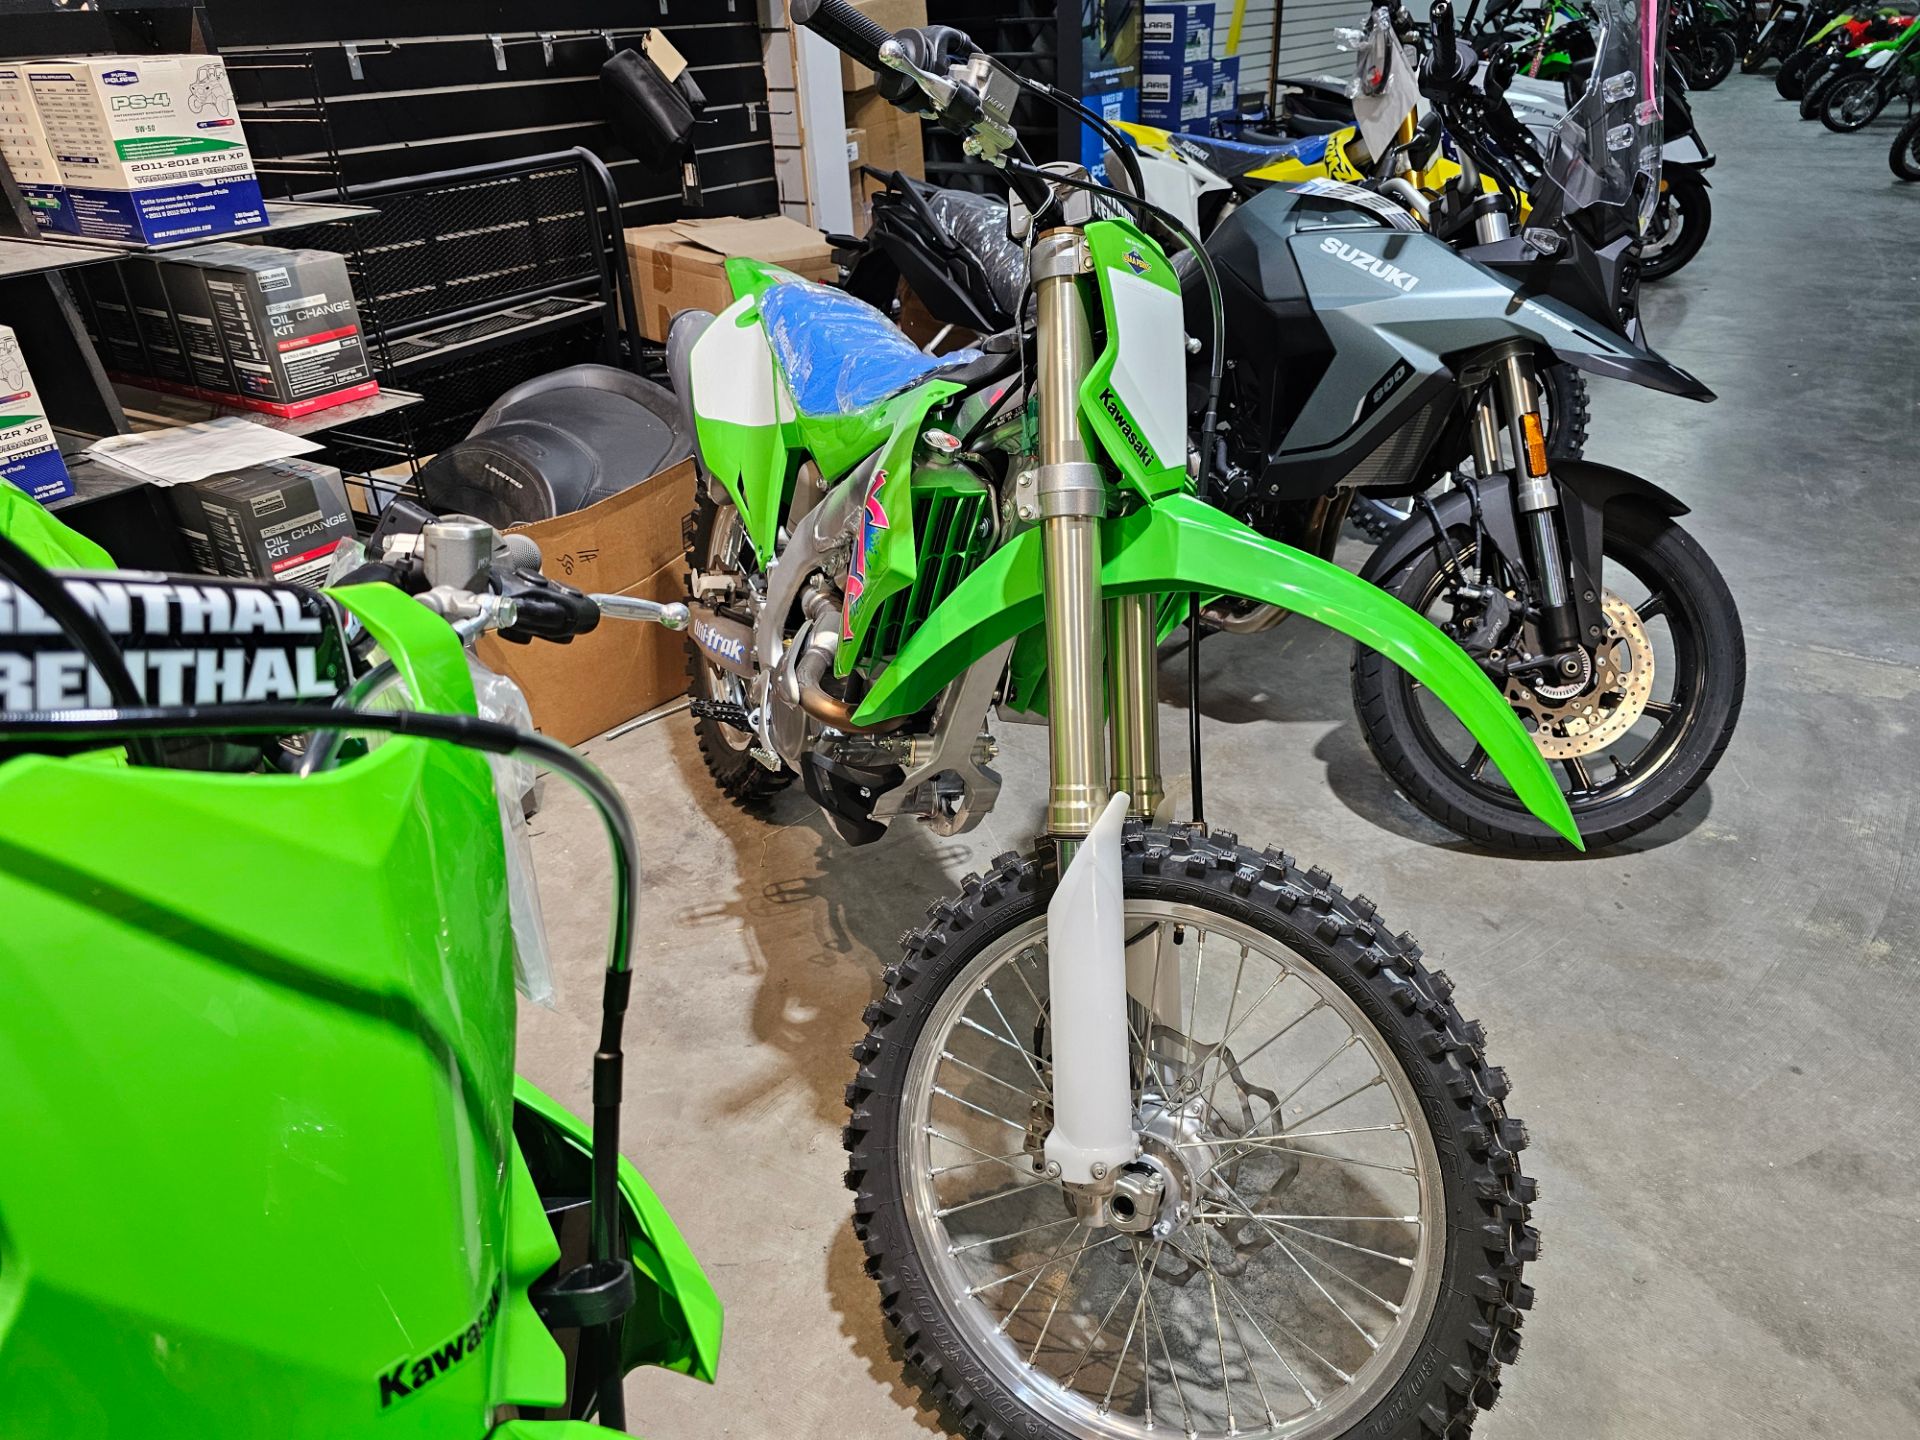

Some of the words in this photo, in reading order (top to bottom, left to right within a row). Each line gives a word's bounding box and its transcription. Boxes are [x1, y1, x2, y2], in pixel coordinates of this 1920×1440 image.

[1144, 21, 1173, 29] LARIS
[111, 92, 171, 111] PS-4
[131, 158, 199, 172] 2011-2012
[202, 153, 226, 163] RZR
[135, 172, 188, 184] TROUSSE
[189, 169, 204, 178] DE
[205, 163, 249, 175] VIDANGE
[217, 175, 250, 185] D'HUILE
[1319, 236, 1420, 292] SUZUKI
[270, 314, 294, 327] OIL
[296, 300, 351, 321] CHANGE
[273, 323, 295, 337] KIT
[1373, 365, 1406, 404] 800
[25, 423, 43, 434] XP
[1099, 387, 1155, 469] Kawasaki
[11, 445, 52, 462] D'HUILE
[484, 463, 524, 489] LIMITED
[264, 536, 288, 549] OIL
[291, 512, 348, 540] CHANGE
[267, 544, 290, 559] KIT
[0, 580, 321, 634] ENTHAL
